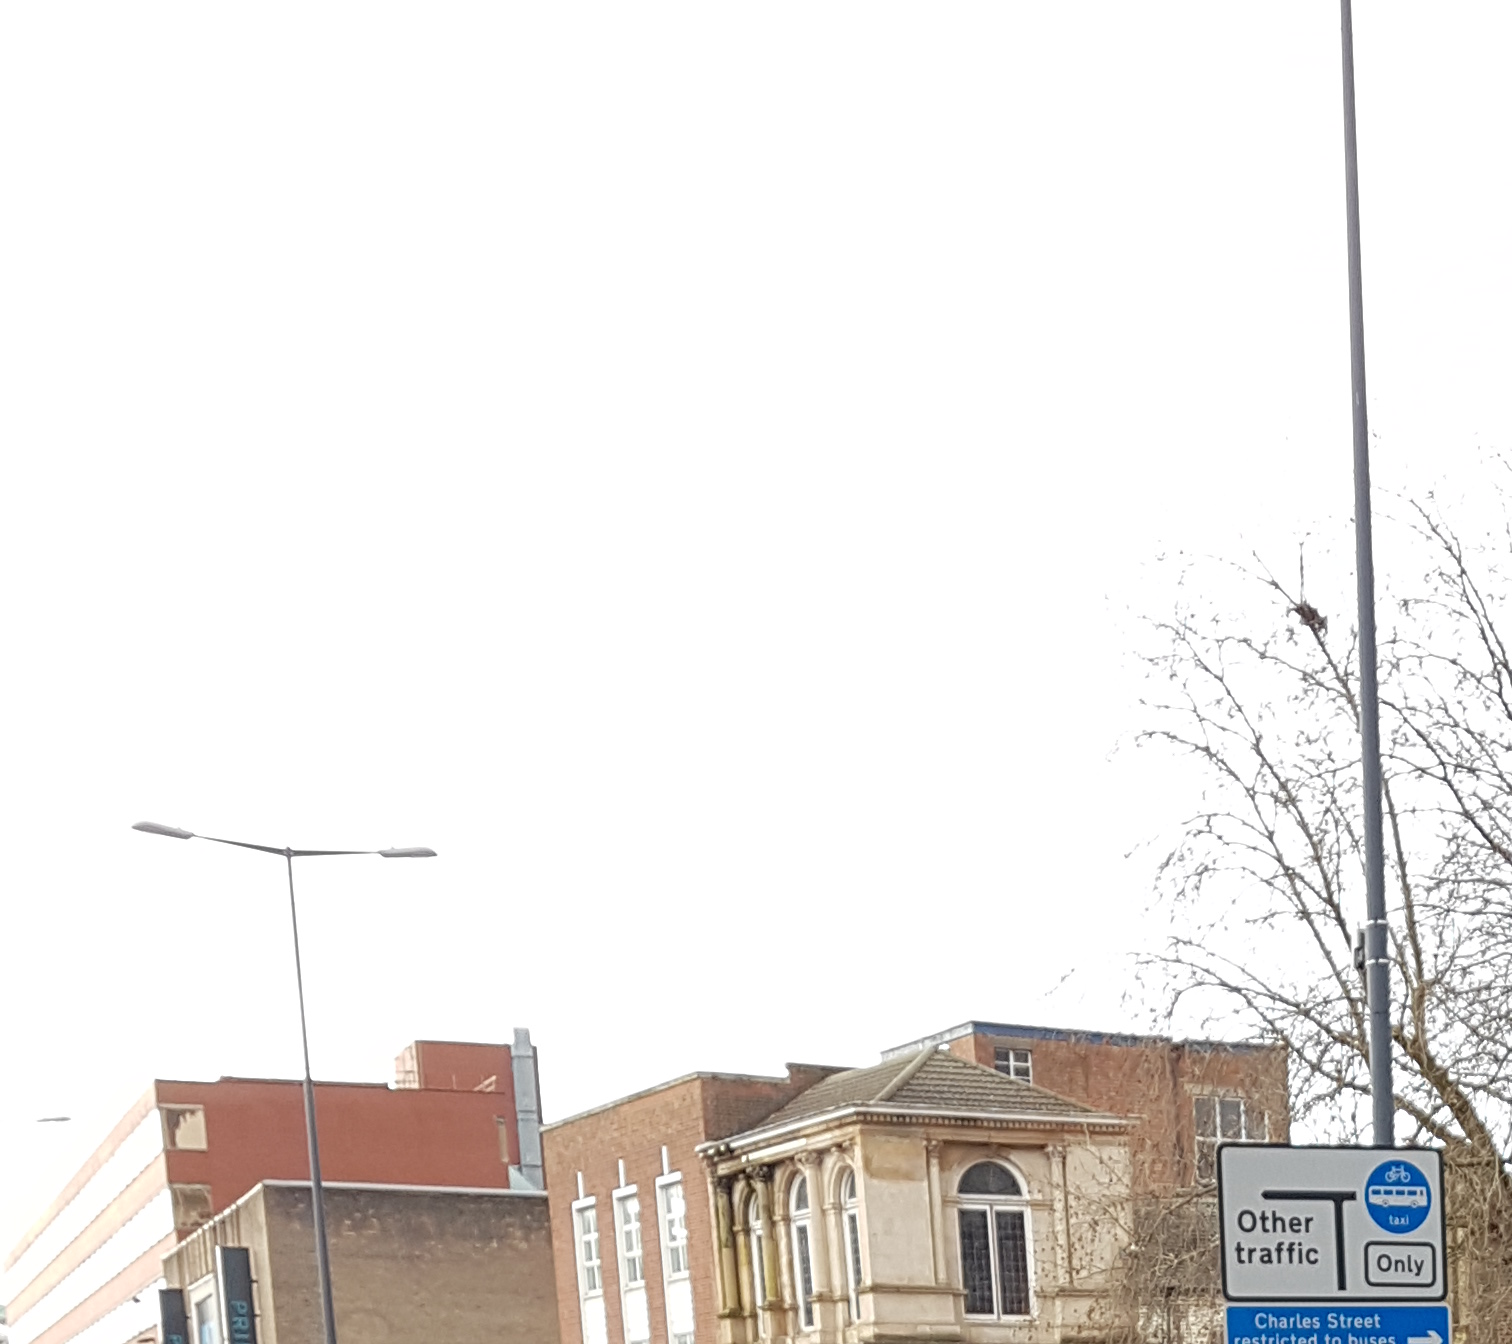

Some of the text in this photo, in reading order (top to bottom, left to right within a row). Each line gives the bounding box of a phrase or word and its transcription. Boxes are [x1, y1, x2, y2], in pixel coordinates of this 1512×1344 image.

[1237, 1209, 1314, 1233] Other
[1389, 1215, 1409, 1226] taxi
[1235, 1241, 1319, 1265] traffic
[1377, 1253, 1424, 1276] Only
[1254, 1313, 1381, 1329] Charles Street
